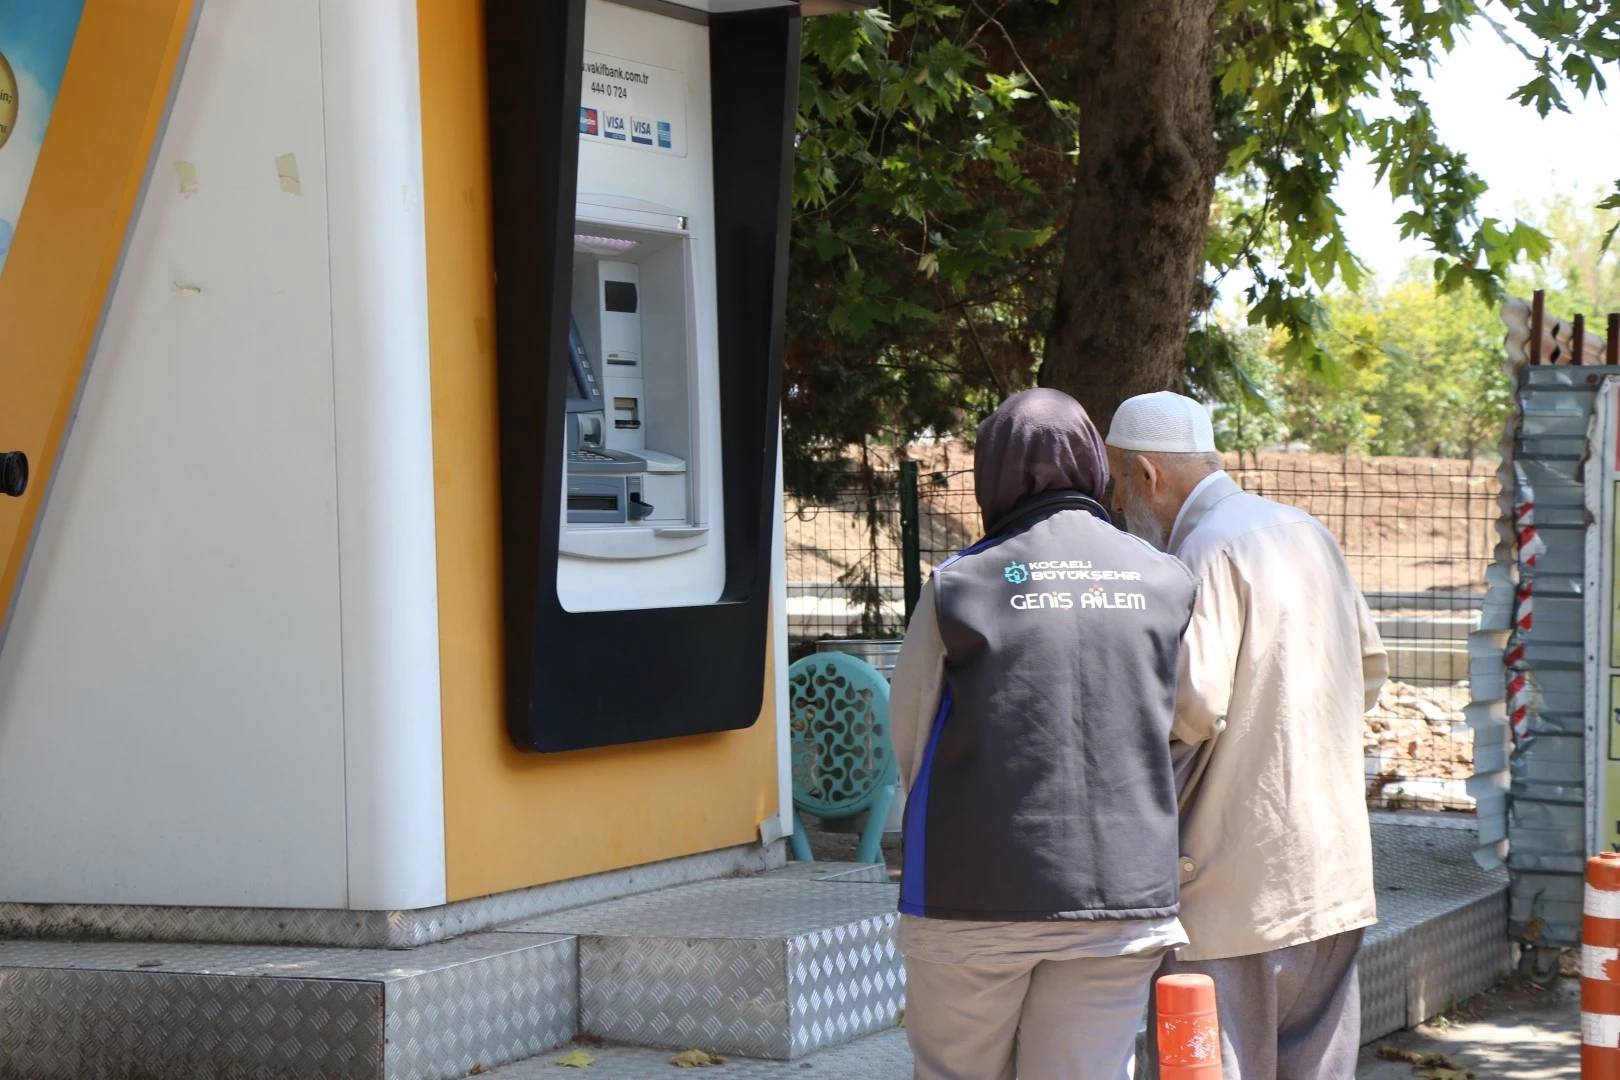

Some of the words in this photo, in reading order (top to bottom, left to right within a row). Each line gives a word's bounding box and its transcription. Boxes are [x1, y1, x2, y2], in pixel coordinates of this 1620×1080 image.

[583, 62, 649, 84] .vakifbank.com.tr
[591, 81, 605, 95] 444
[606, 84, 612, 96] 0
[613, 85, 627, 99] 724
[606, 115, 625, 130] VISA
[633, 120, 652, 135] VISA
[1031, 570, 1142, 582] BÜYÜKŞEHİR
